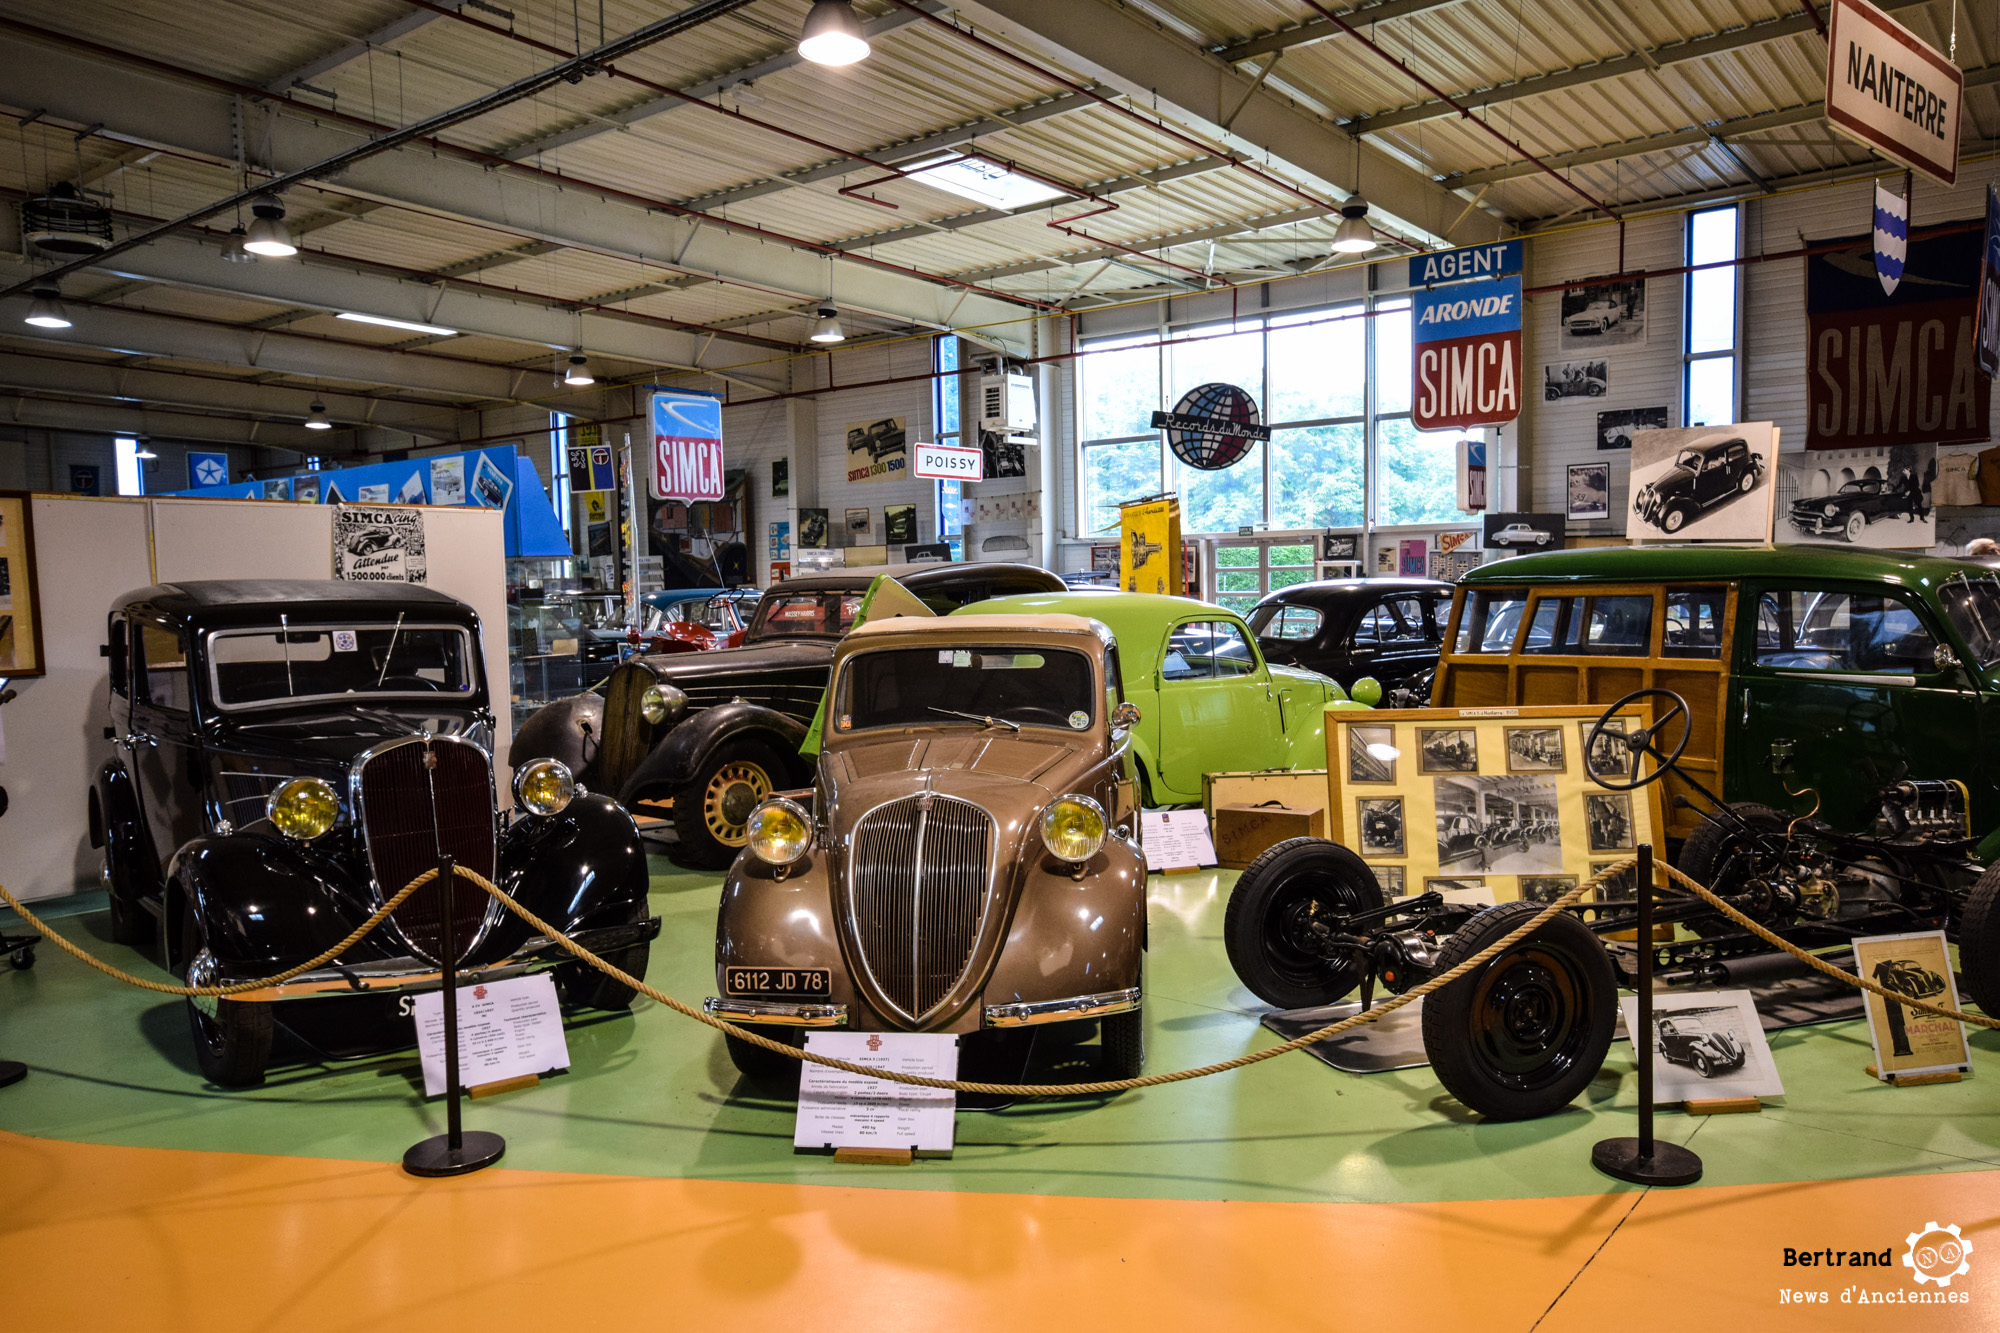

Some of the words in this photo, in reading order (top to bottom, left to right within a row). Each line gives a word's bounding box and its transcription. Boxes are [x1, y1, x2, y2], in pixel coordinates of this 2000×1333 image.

[1847, 40, 1947, 140] NANTERRE
[1423, 245, 1507, 281] AGENT
[1419, 294, 1513, 325] ARONDE
[1420, 340, 1516, 419] SIMCA
[1817, 315, 1977, 437] SIMCA
[1158, 413, 1219, 434] Records
[1232, 422, 1267, 440] Monde
[660, 440, 721, 495] SIMCA
[848, 466, 870, 482] simca
[870, 462, 887, 476] 1300
[887, 457, 905, 472] 1500
[926, 455, 975, 470] POISSY
[341, 511, 393, 524] SIMCA
[393, 513, 418, 528] cing
[353, 553, 399, 570] Attendue
[1402, 556, 1425, 575] SIMCA
[1222, 815, 1271, 845] SIMCA
[734, 972, 770, 990] 6112
[776, 972, 796, 990] JD
[801, 973, 822, 990] 78
[1905, 1022, 1955, 1034] MARCHAL
